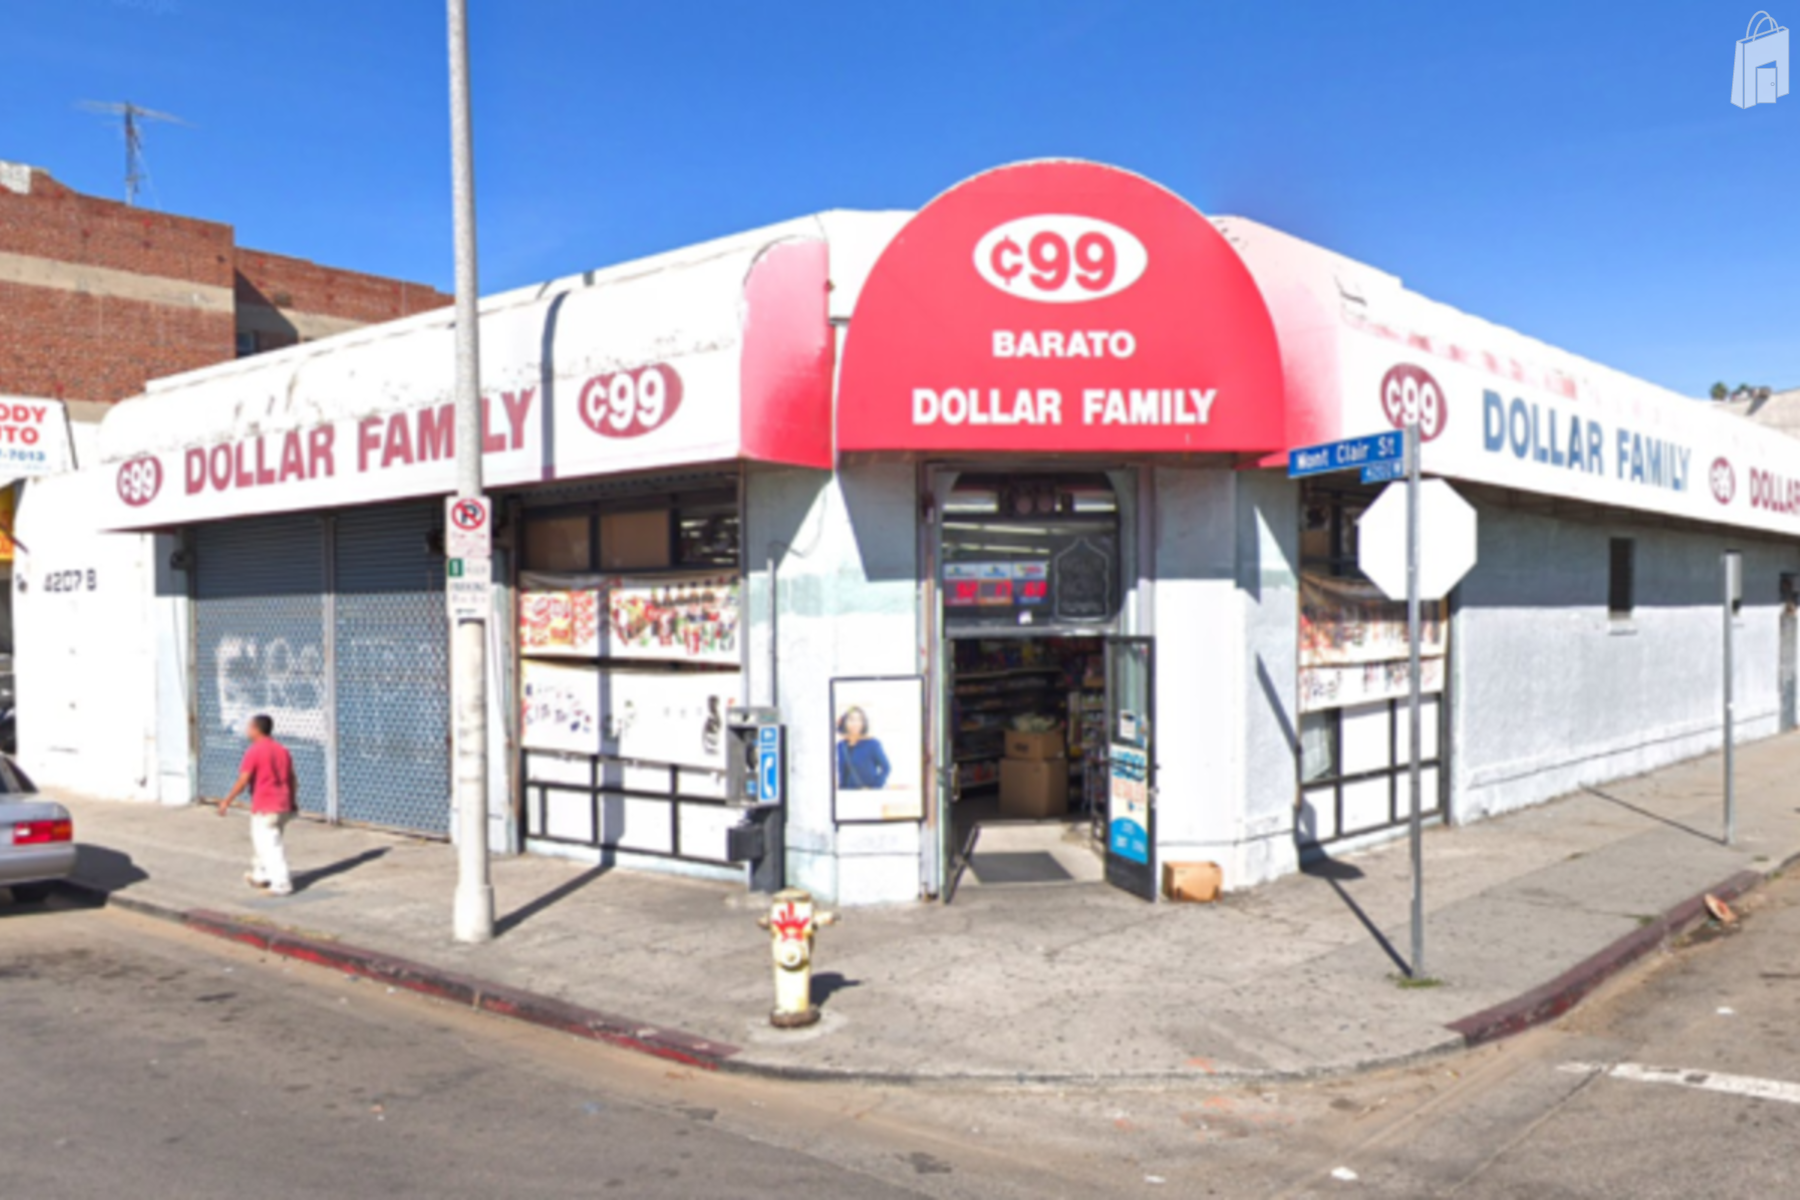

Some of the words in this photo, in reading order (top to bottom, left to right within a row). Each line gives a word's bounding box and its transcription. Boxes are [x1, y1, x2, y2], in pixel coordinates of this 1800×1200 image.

[992, 329, 1136, 359] BARATO
[912, 387, 1063, 425] DOLLAR
[1082, 387, 1217, 425] FAMILY
[0, 425, 40, 446] TO
[184, 421, 335, 496] DOLLAR
[357, 386, 536, 473] FAMLY
[1335, 443, 1371, 464] Clair
[1377, 436, 1395, 457] St
[1483, 389, 1606, 477] DOLLAR
[1615, 428, 1692, 494] FAMILY
